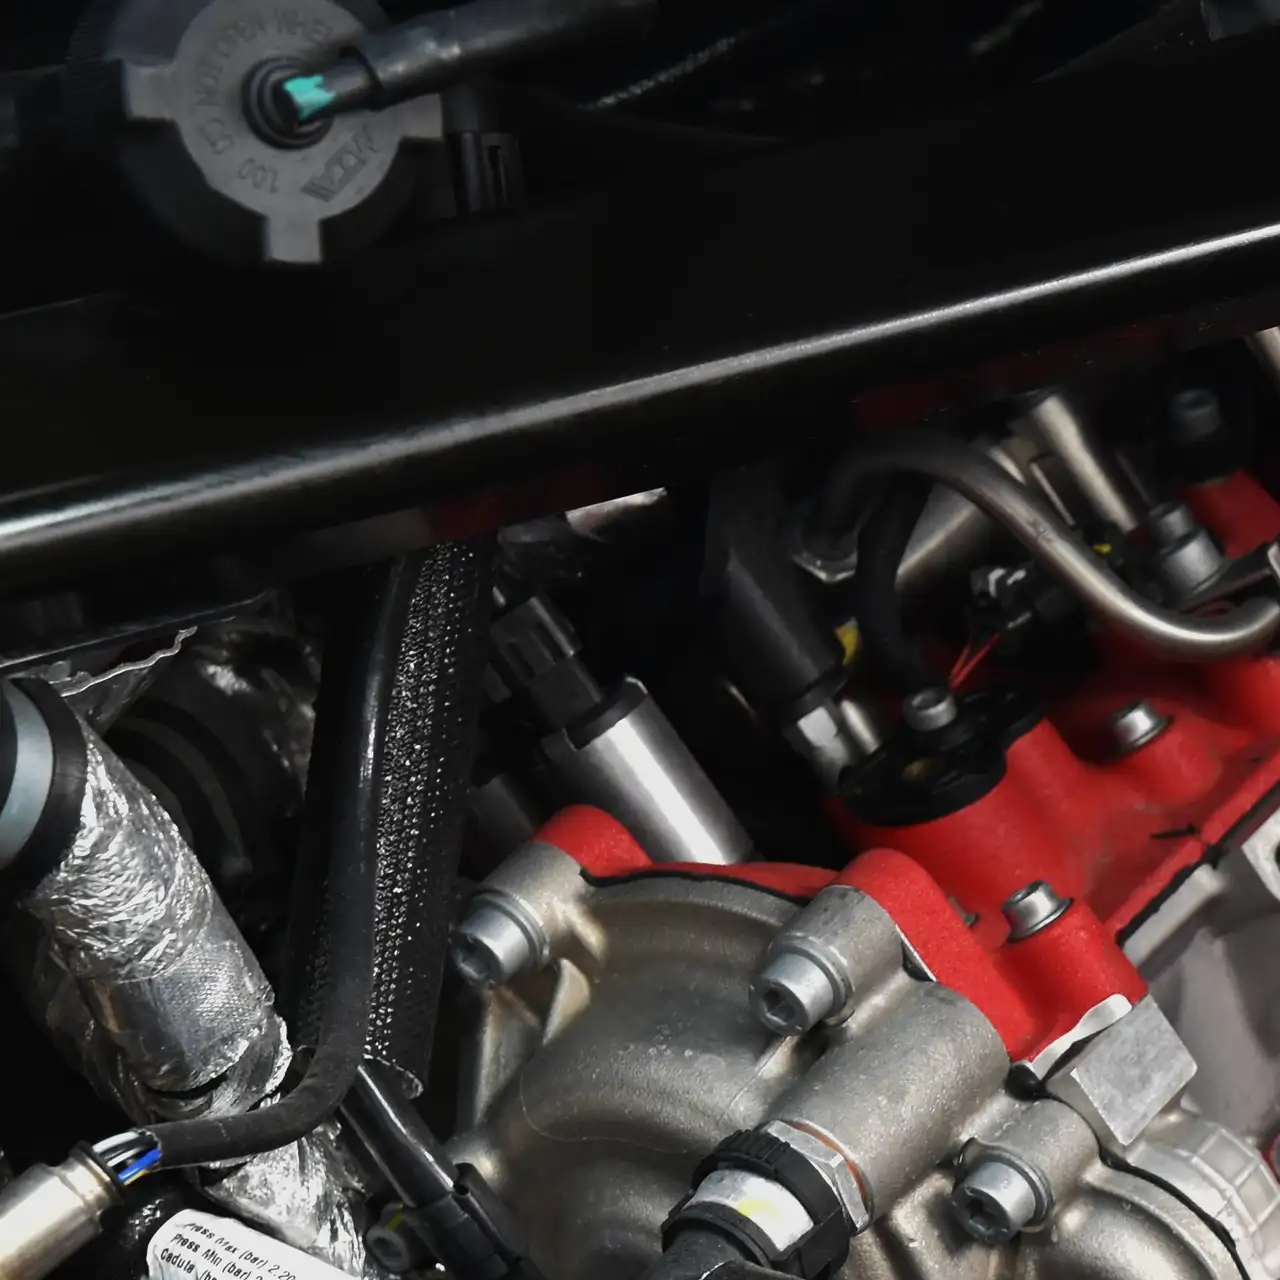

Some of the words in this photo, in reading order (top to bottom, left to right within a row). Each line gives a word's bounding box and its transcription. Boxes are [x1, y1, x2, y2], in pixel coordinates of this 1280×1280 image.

[170, 1233, 201, 1253] Press
[201, 1248, 223, 1267] Min
[239, 1250, 268, 1270] (bar)
